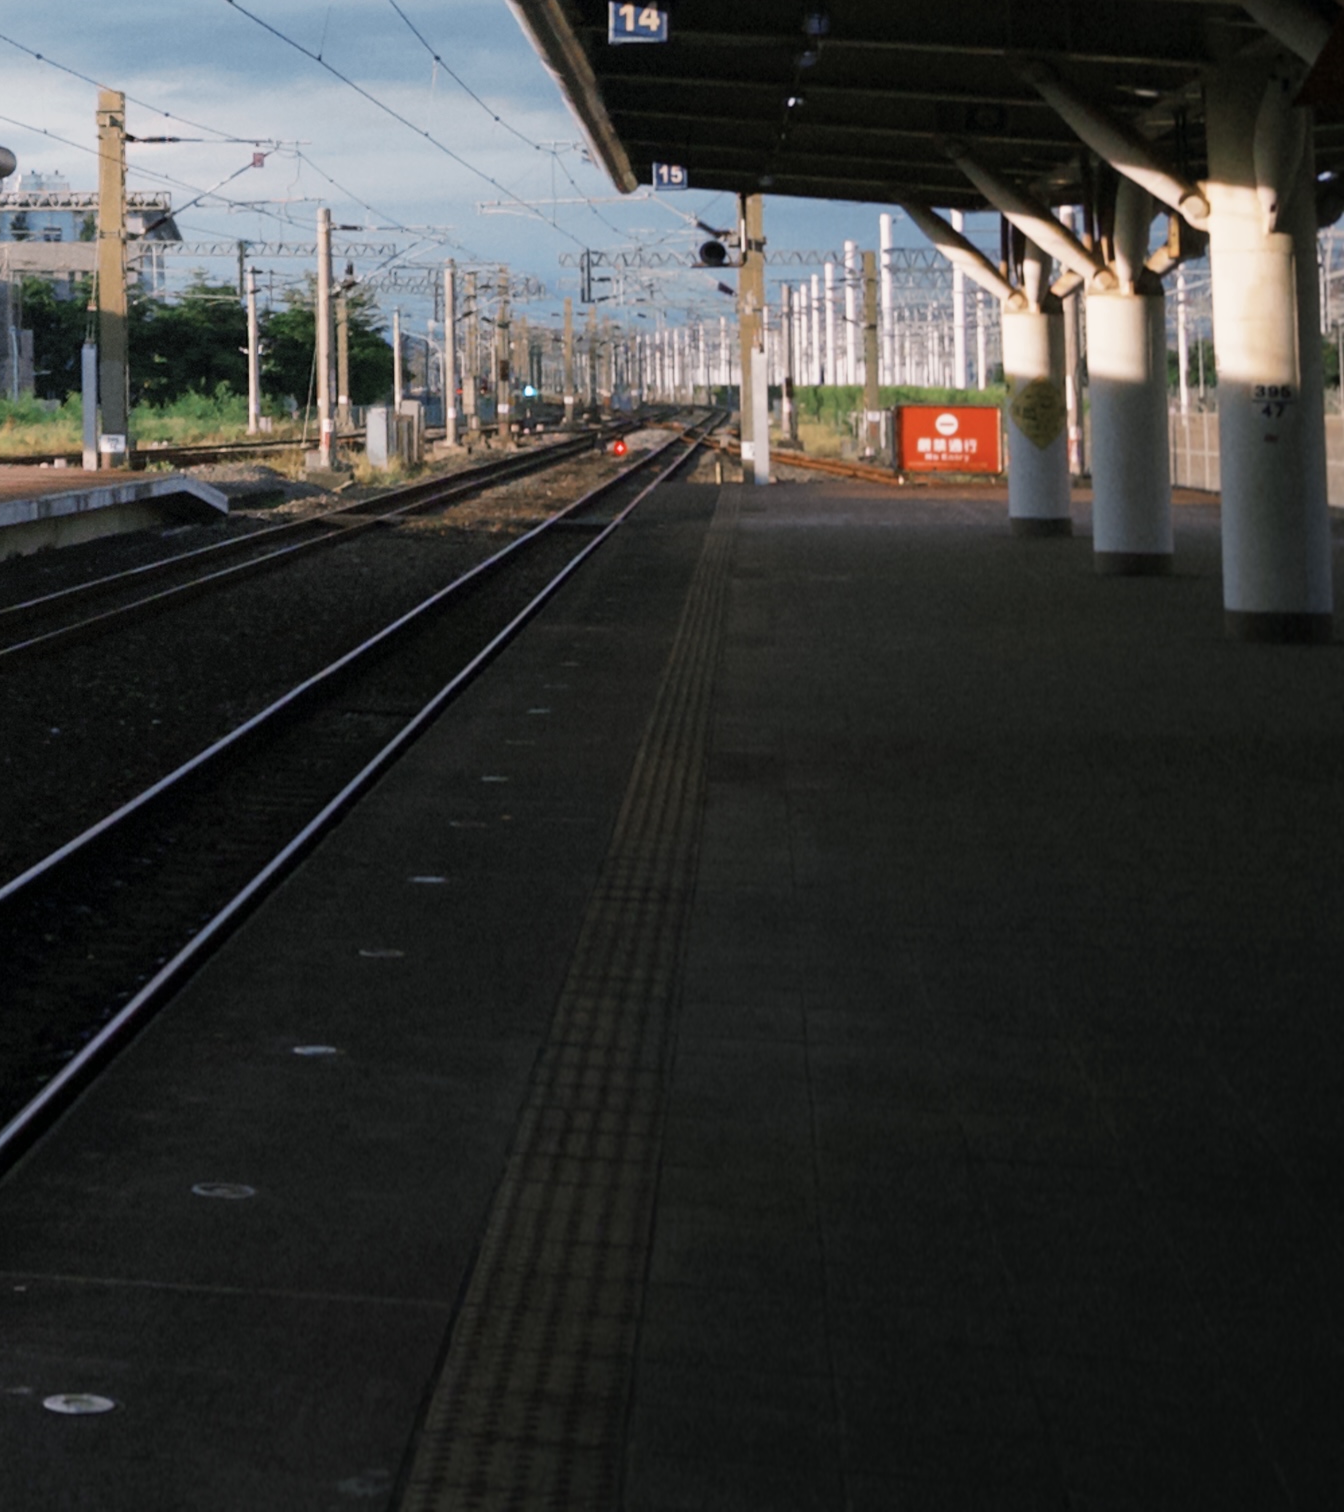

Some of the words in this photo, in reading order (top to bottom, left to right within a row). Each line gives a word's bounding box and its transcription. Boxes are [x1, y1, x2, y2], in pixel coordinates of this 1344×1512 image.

[619, 2, 661, 31] 14
[659, 164, 683, 183] 15
[940, 452, 970, 463] Entry
